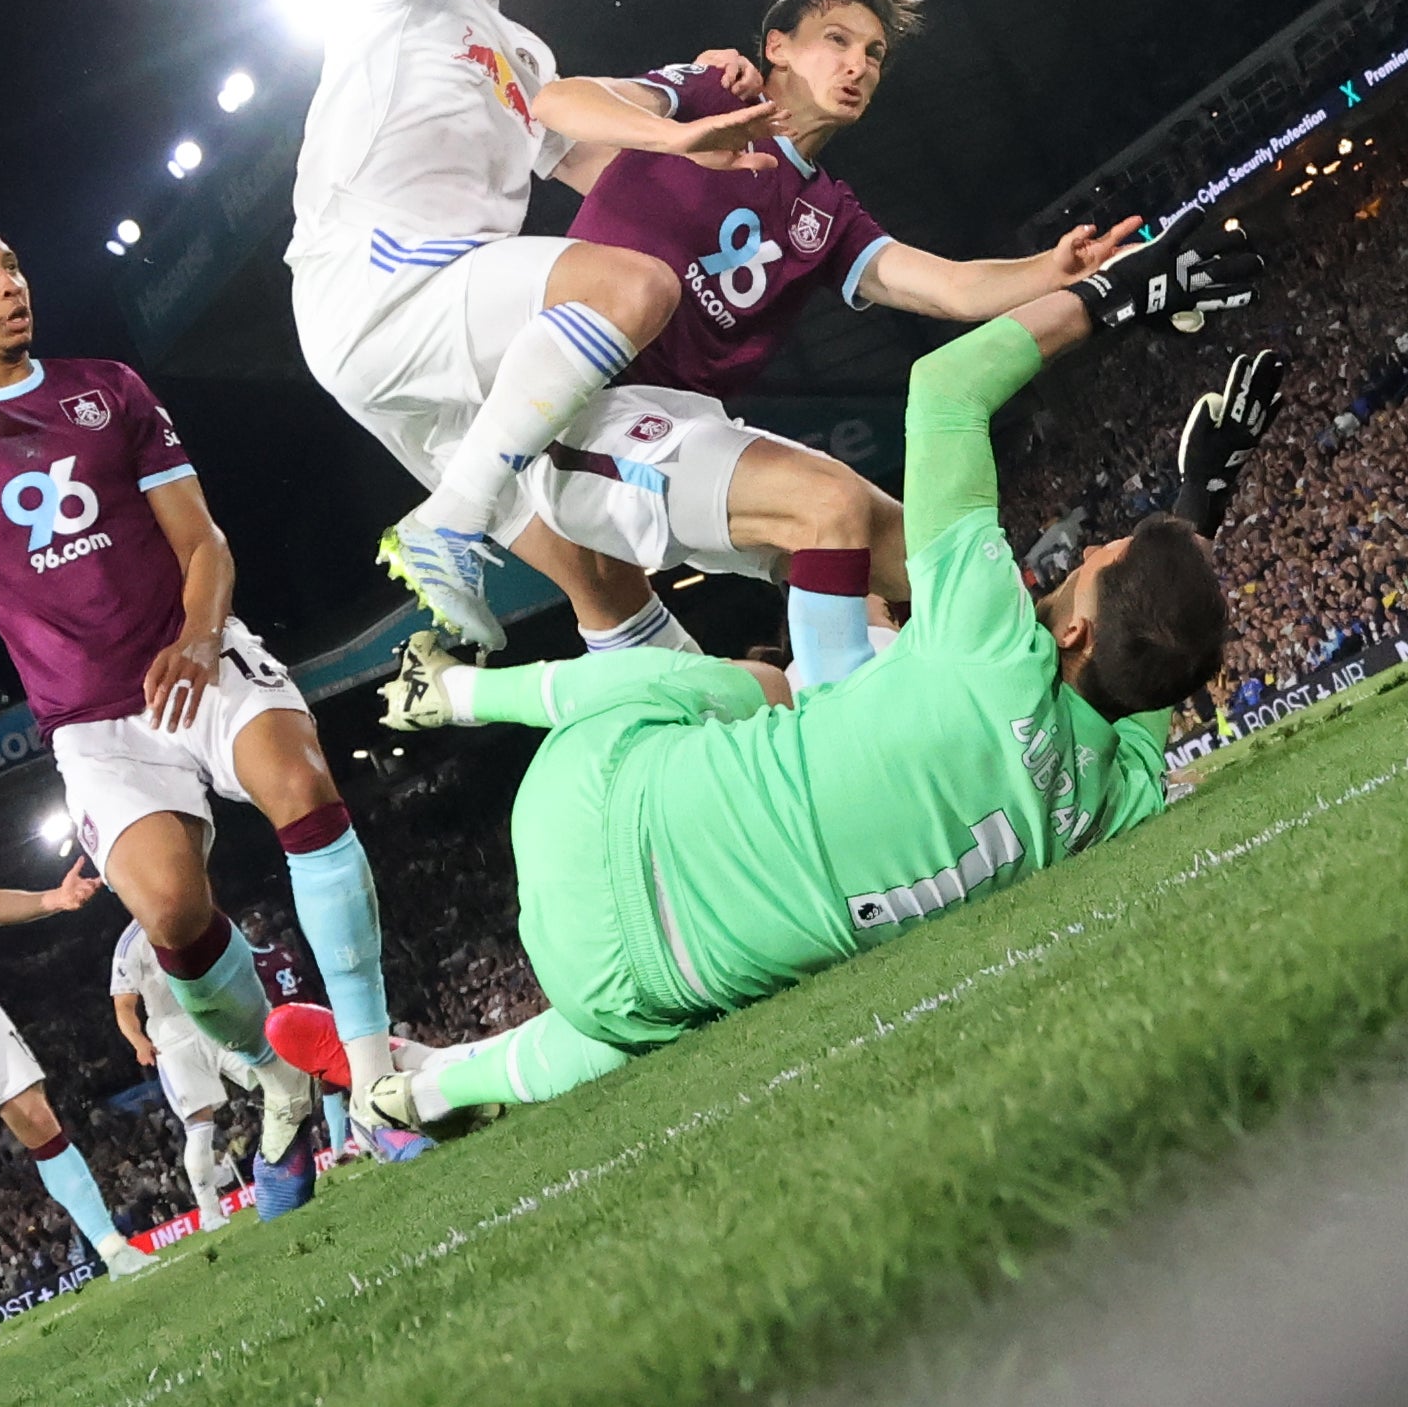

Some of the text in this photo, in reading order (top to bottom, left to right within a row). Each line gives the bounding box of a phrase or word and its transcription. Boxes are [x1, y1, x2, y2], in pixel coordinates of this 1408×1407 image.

[1197, 174, 1231, 204] Cyber
[1229, 144, 1275, 185] Security
[1270, 108, 1326, 154] Protection
[698, 207, 783, 309] 96
[685, 263, 737, 330] 96.com
[1, 456, 99, 552] 96
[30, 531, 112, 574] 96.com
[1244, 685, 1313, 733] BOOST
[1331, 662, 1366, 693] AIR
[58, 1266, 95, 1295] AIR
